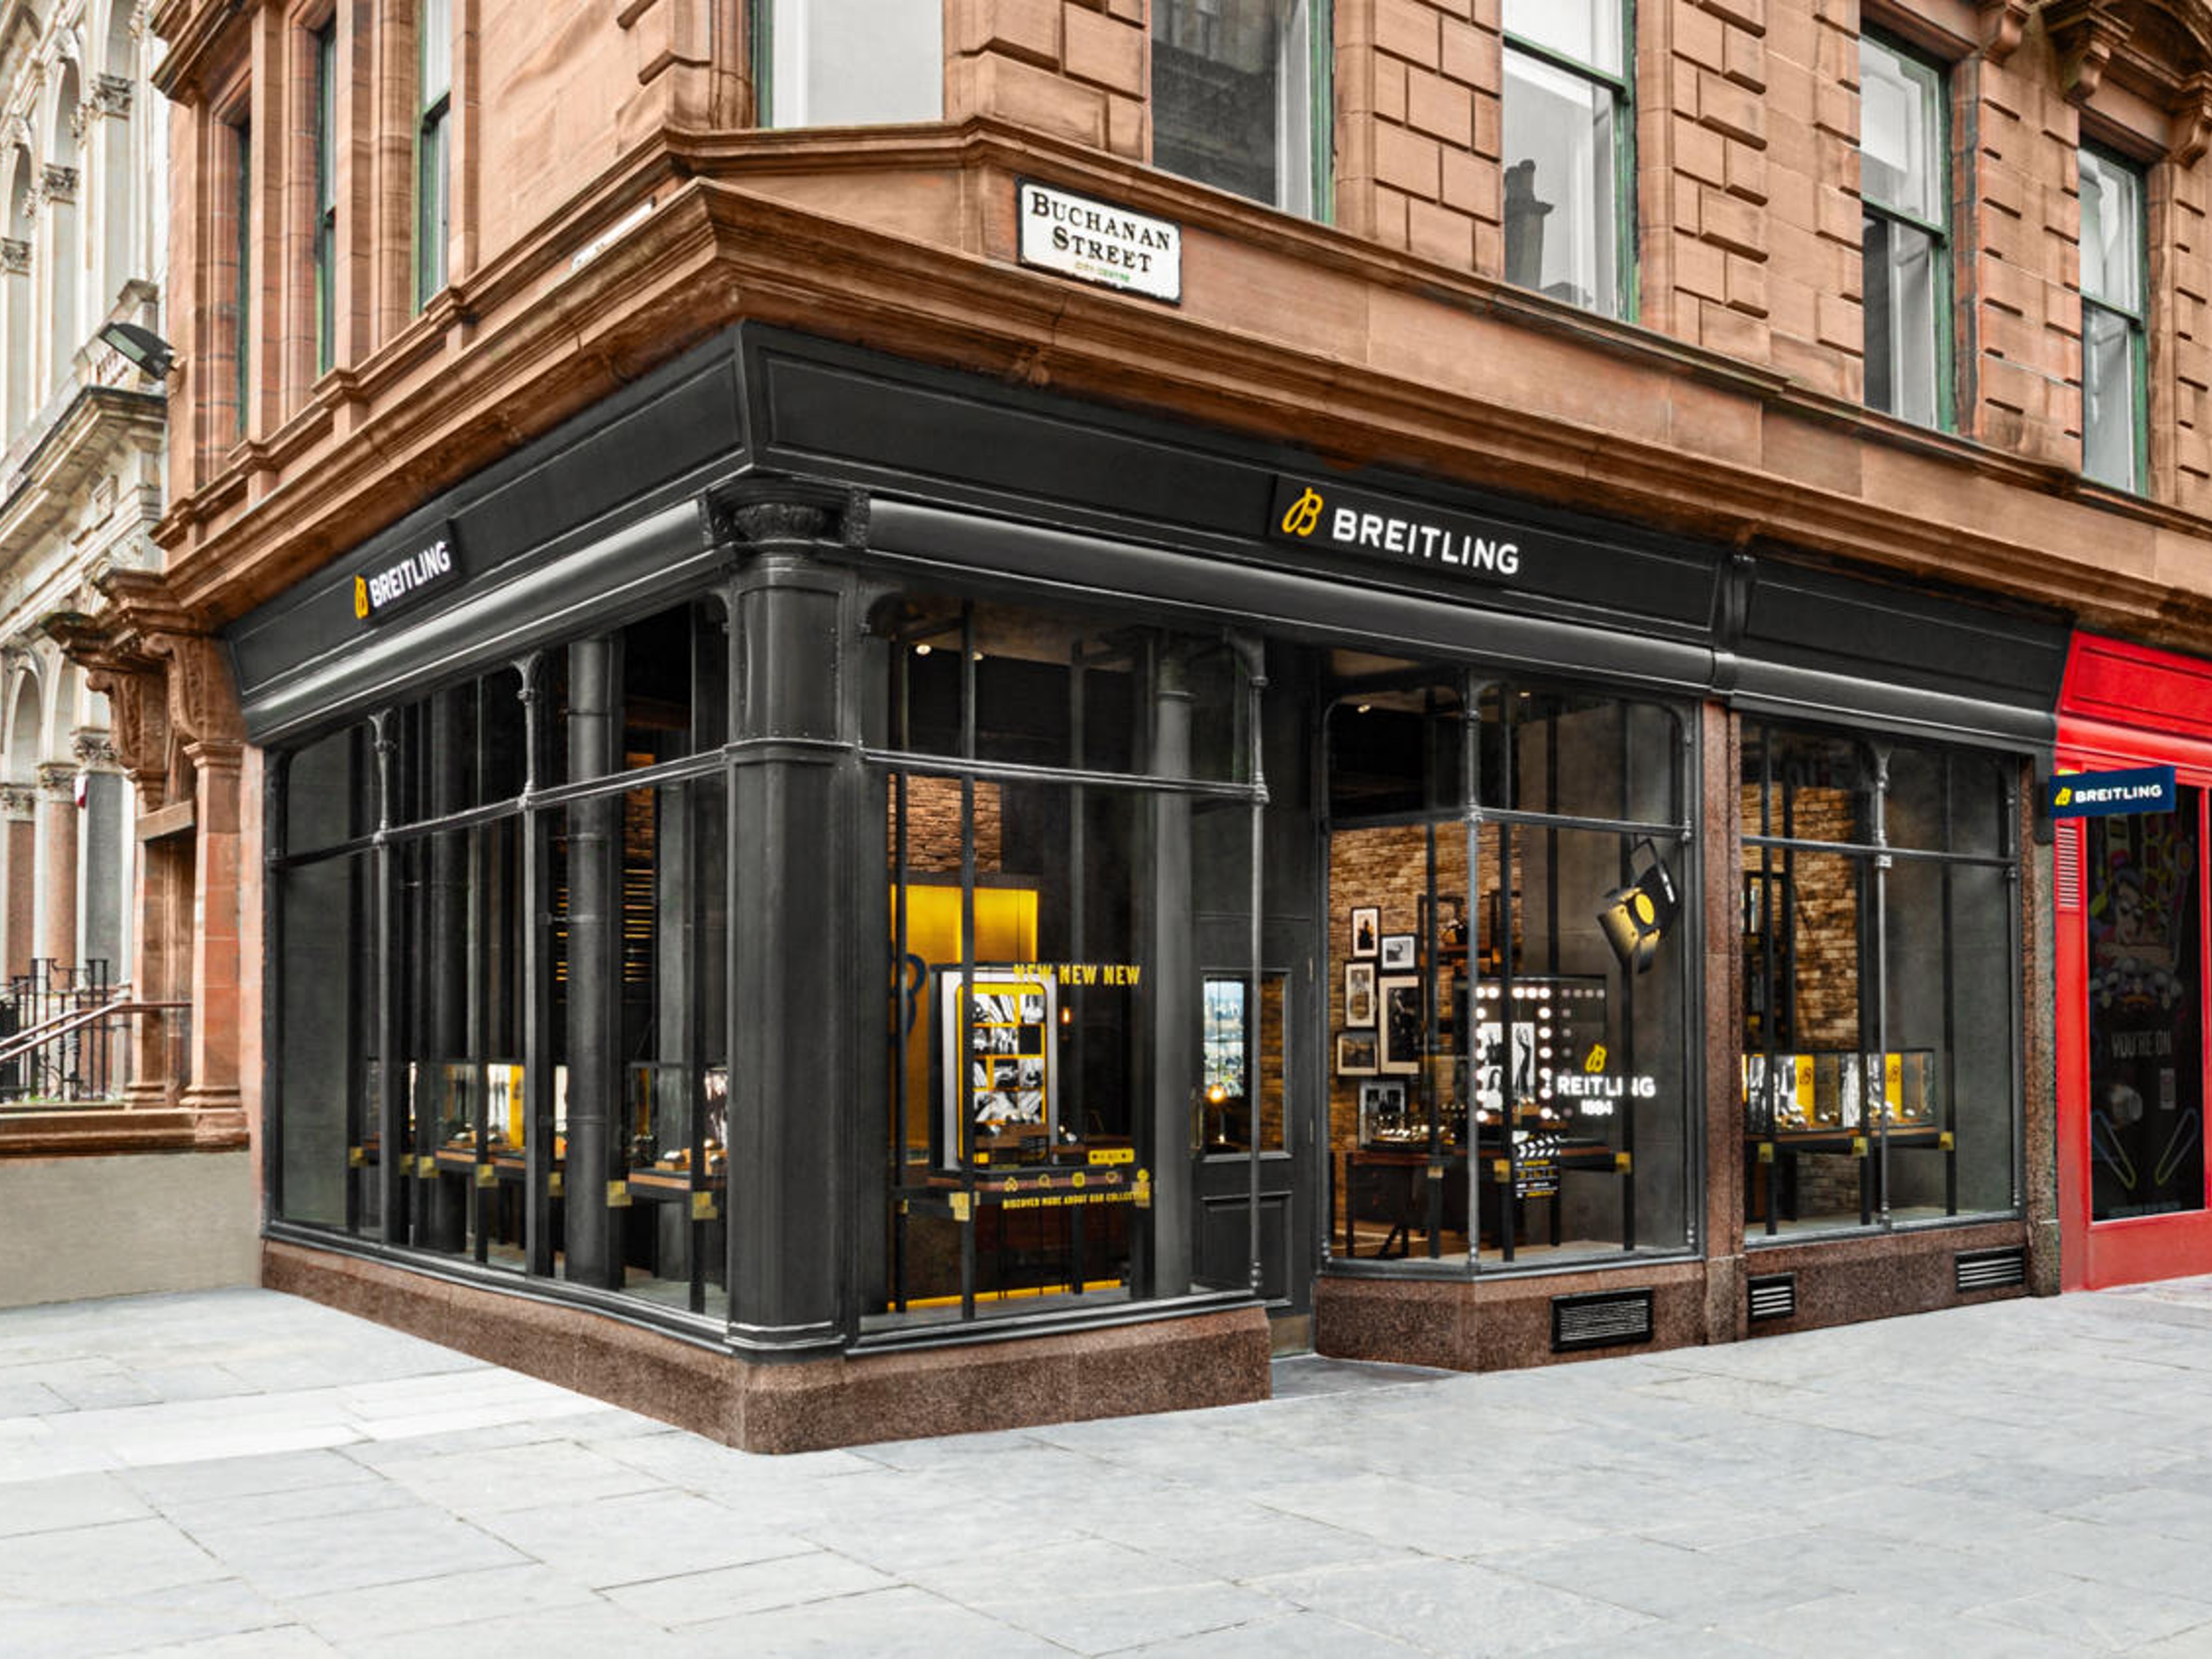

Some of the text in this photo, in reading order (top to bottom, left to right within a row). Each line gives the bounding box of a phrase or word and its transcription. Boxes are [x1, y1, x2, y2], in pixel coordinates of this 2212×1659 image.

[1031, 192, 1170, 250] BUCHANAN
[1052, 226, 1152, 272] STREET
[1332, 507, 1519, 574] BREITLING
[369, 541, 451, 608] BREITLING
[2075, 785, 2162, 803] BREITLING
[1059, 964, 1097, 984] NEW
[1103, 965, 1140, 985] NEW
[1546, 1075, 1656, 1097] REITLIG
